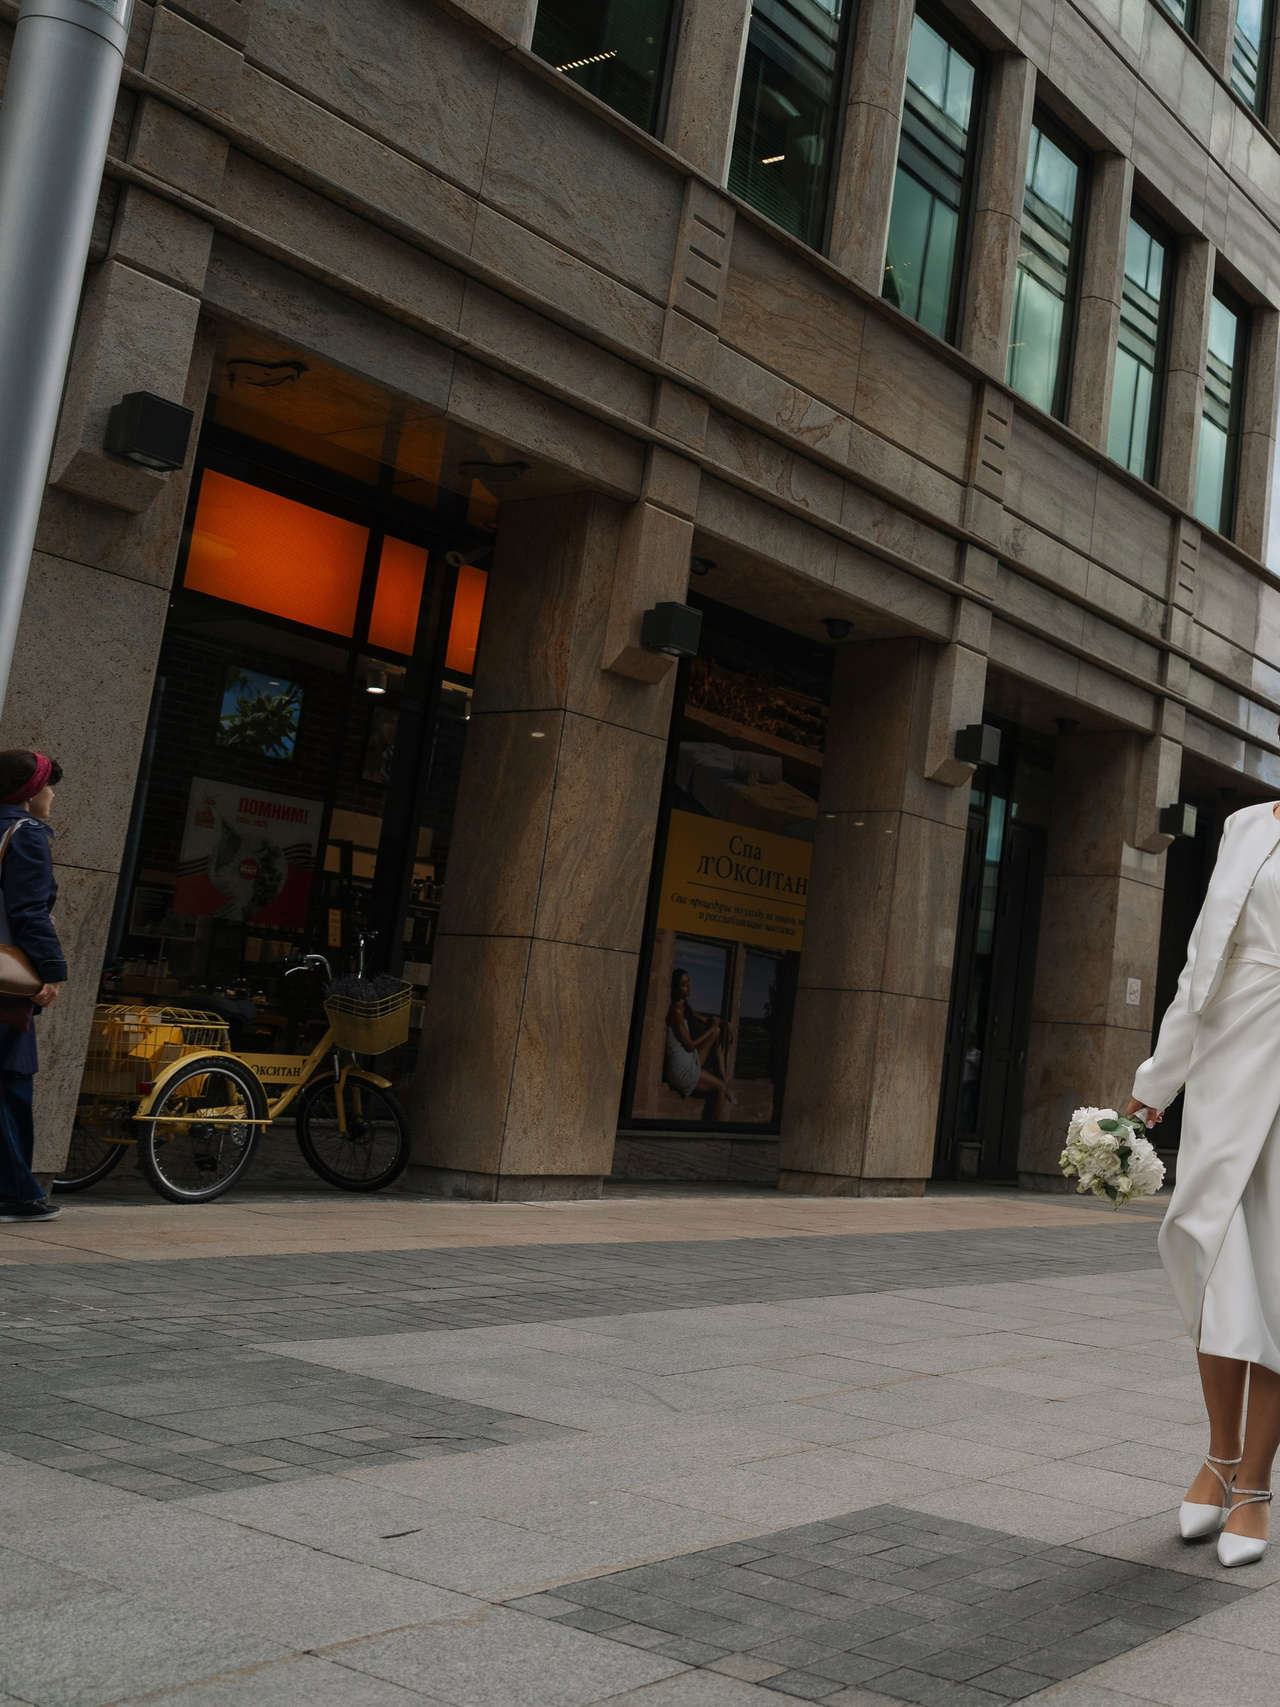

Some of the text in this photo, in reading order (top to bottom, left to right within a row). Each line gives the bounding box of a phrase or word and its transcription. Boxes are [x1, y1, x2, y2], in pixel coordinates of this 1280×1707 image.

[238, 797, 309, 825] ПОМНИМ!
[729, 835, 762, 861] Спа
[698, 911, 705, 919] и
